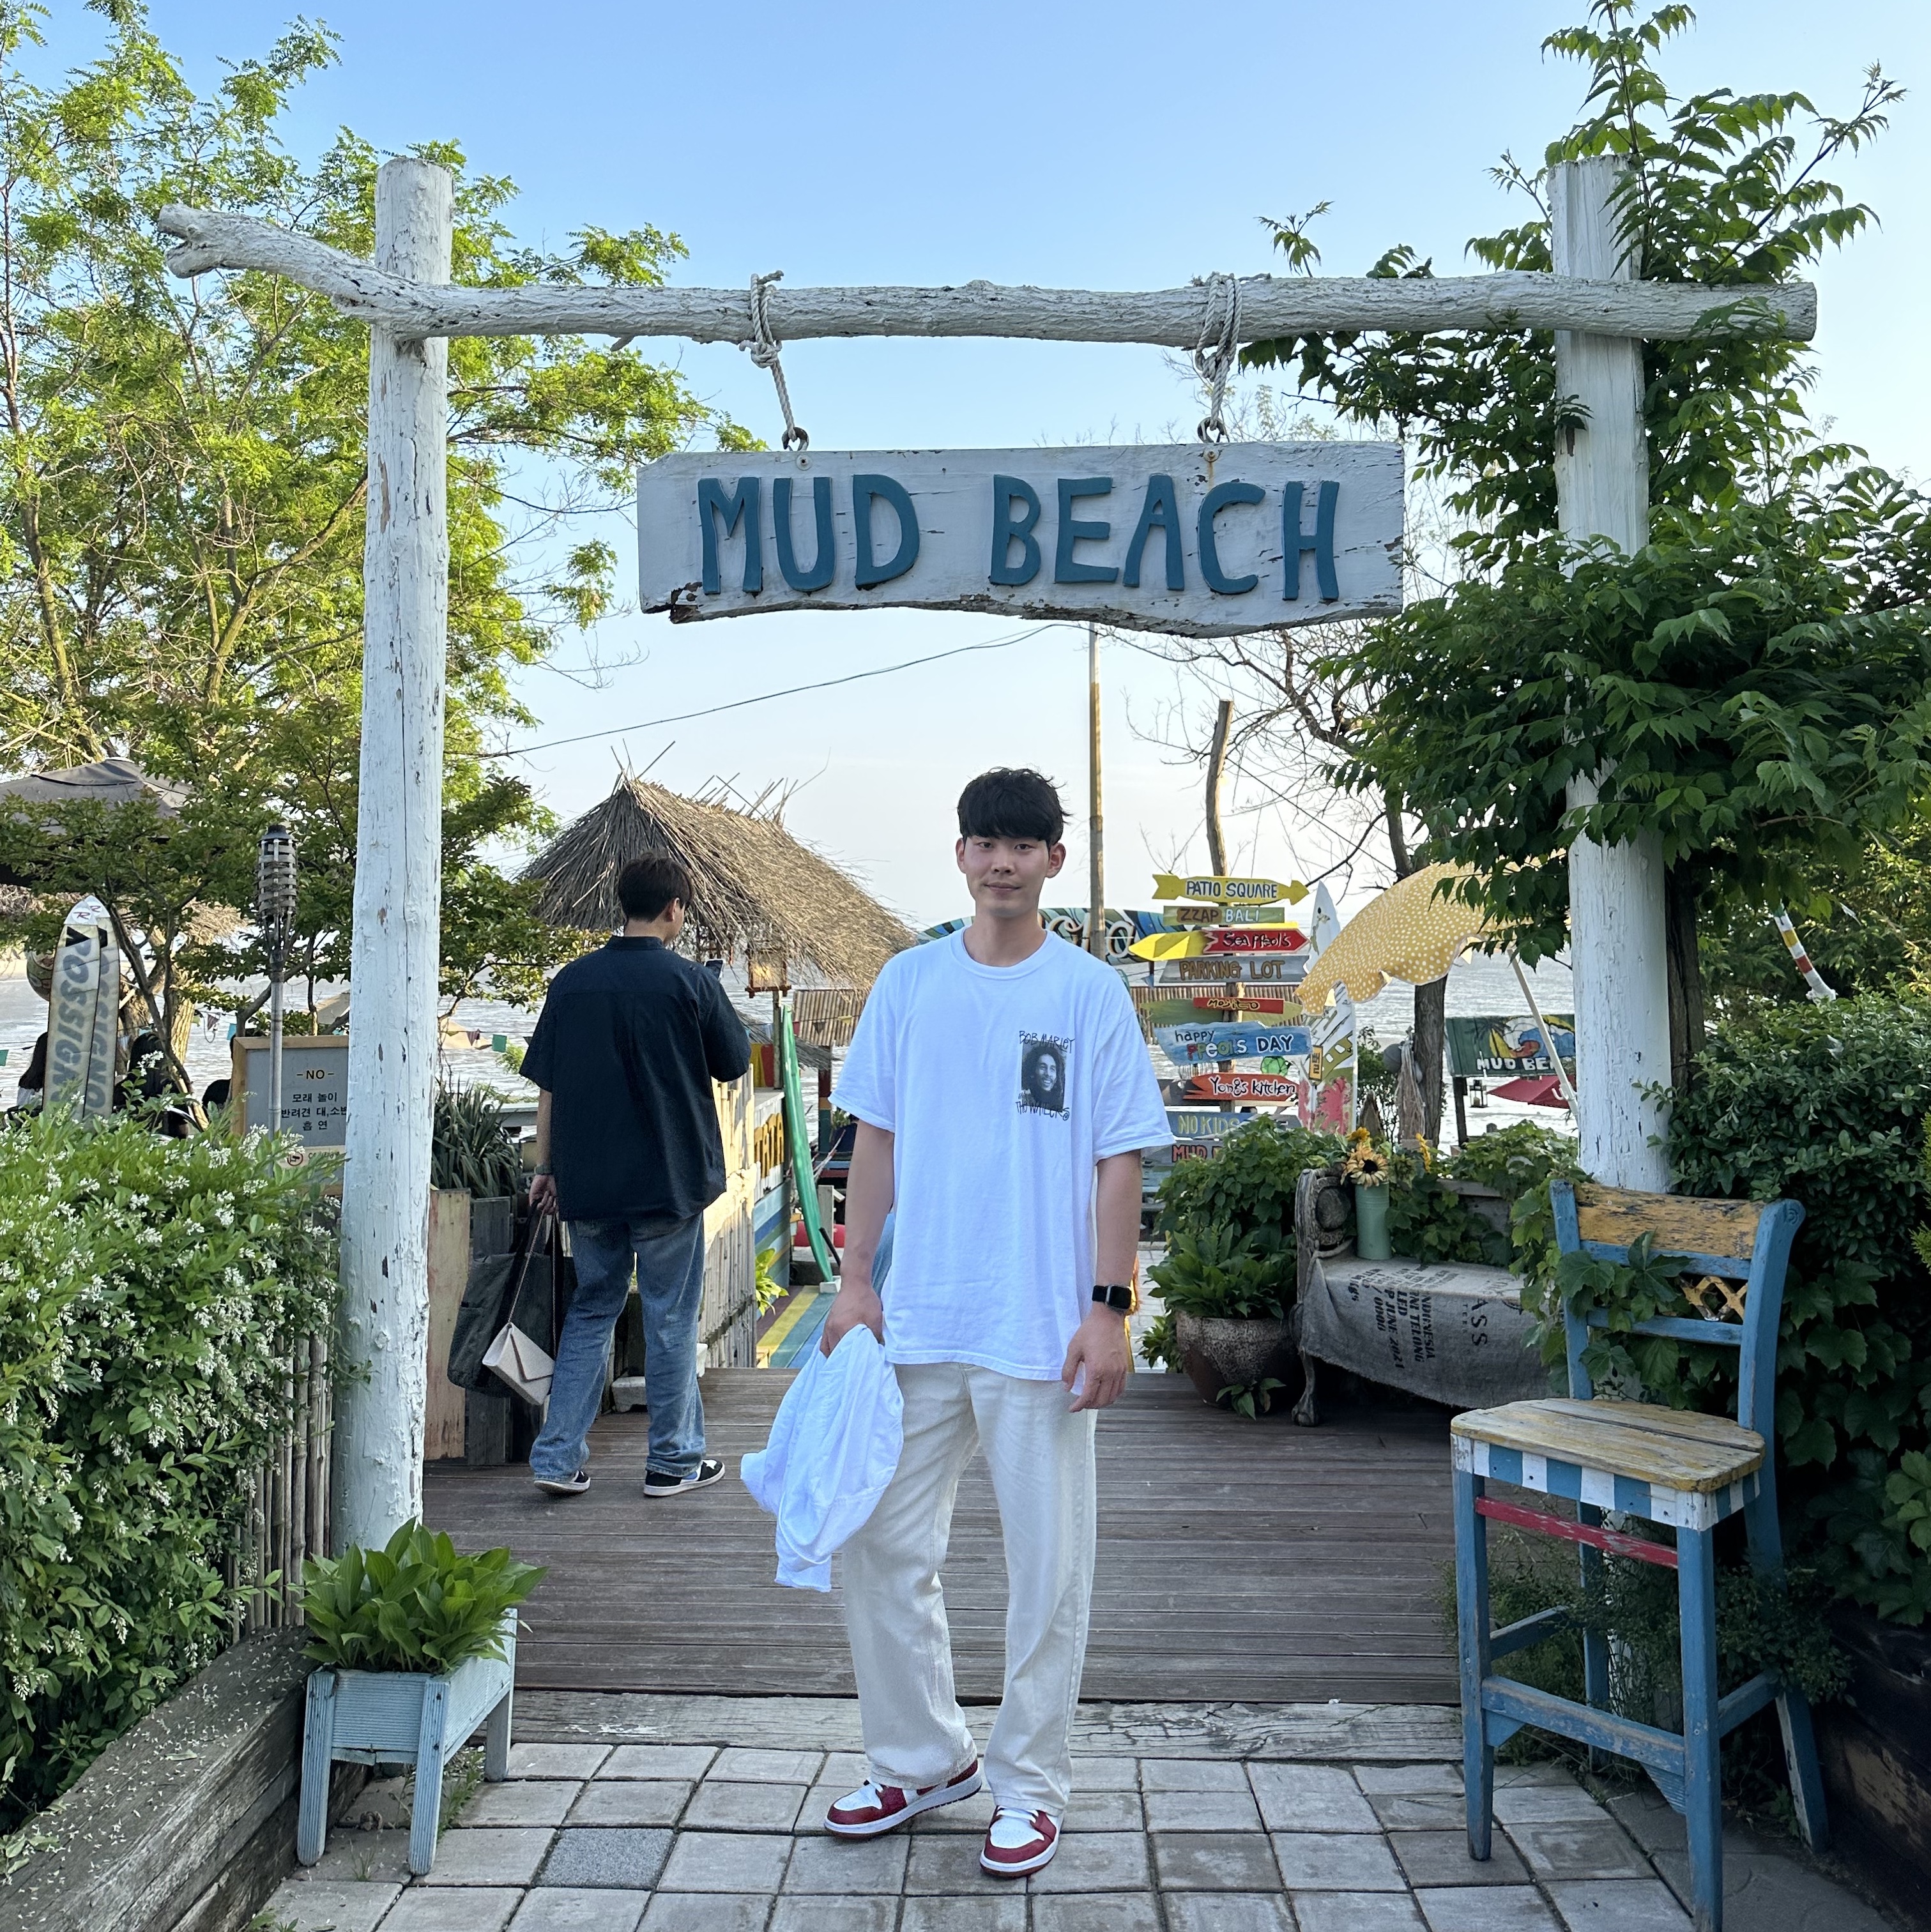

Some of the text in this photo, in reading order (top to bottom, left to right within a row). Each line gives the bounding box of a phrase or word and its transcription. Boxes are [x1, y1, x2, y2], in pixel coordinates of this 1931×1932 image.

[698, 473, 1340, 602] MUD BEACH
[1186, 881, 1278, 899] PATIO SQUARE
[1180, 908, 1260, 922] ZZAP BALI
[1179, 960, 1285, 980] PARKING LOT
[1019, 1030, 1038, 1046] BOB
[1175, 1030, 1215, 1043] happy
[1256, 1034, 1294, 1053] DAY
[1476, 1057, 1516, 1070] MUD
[1209, 1076, 1248, 1097] Yong's
[292, 1092, 337, 1103] 모래 놀이
[281, 1107, 310, 1118] 반려견
[318, 1120, 328, 1130] 연
[1178, 1115, 1198, 1134] NO
[1172, 1145, 1207, 1162] MUD
[1410, 1314, 1425, 1362] TELONG
